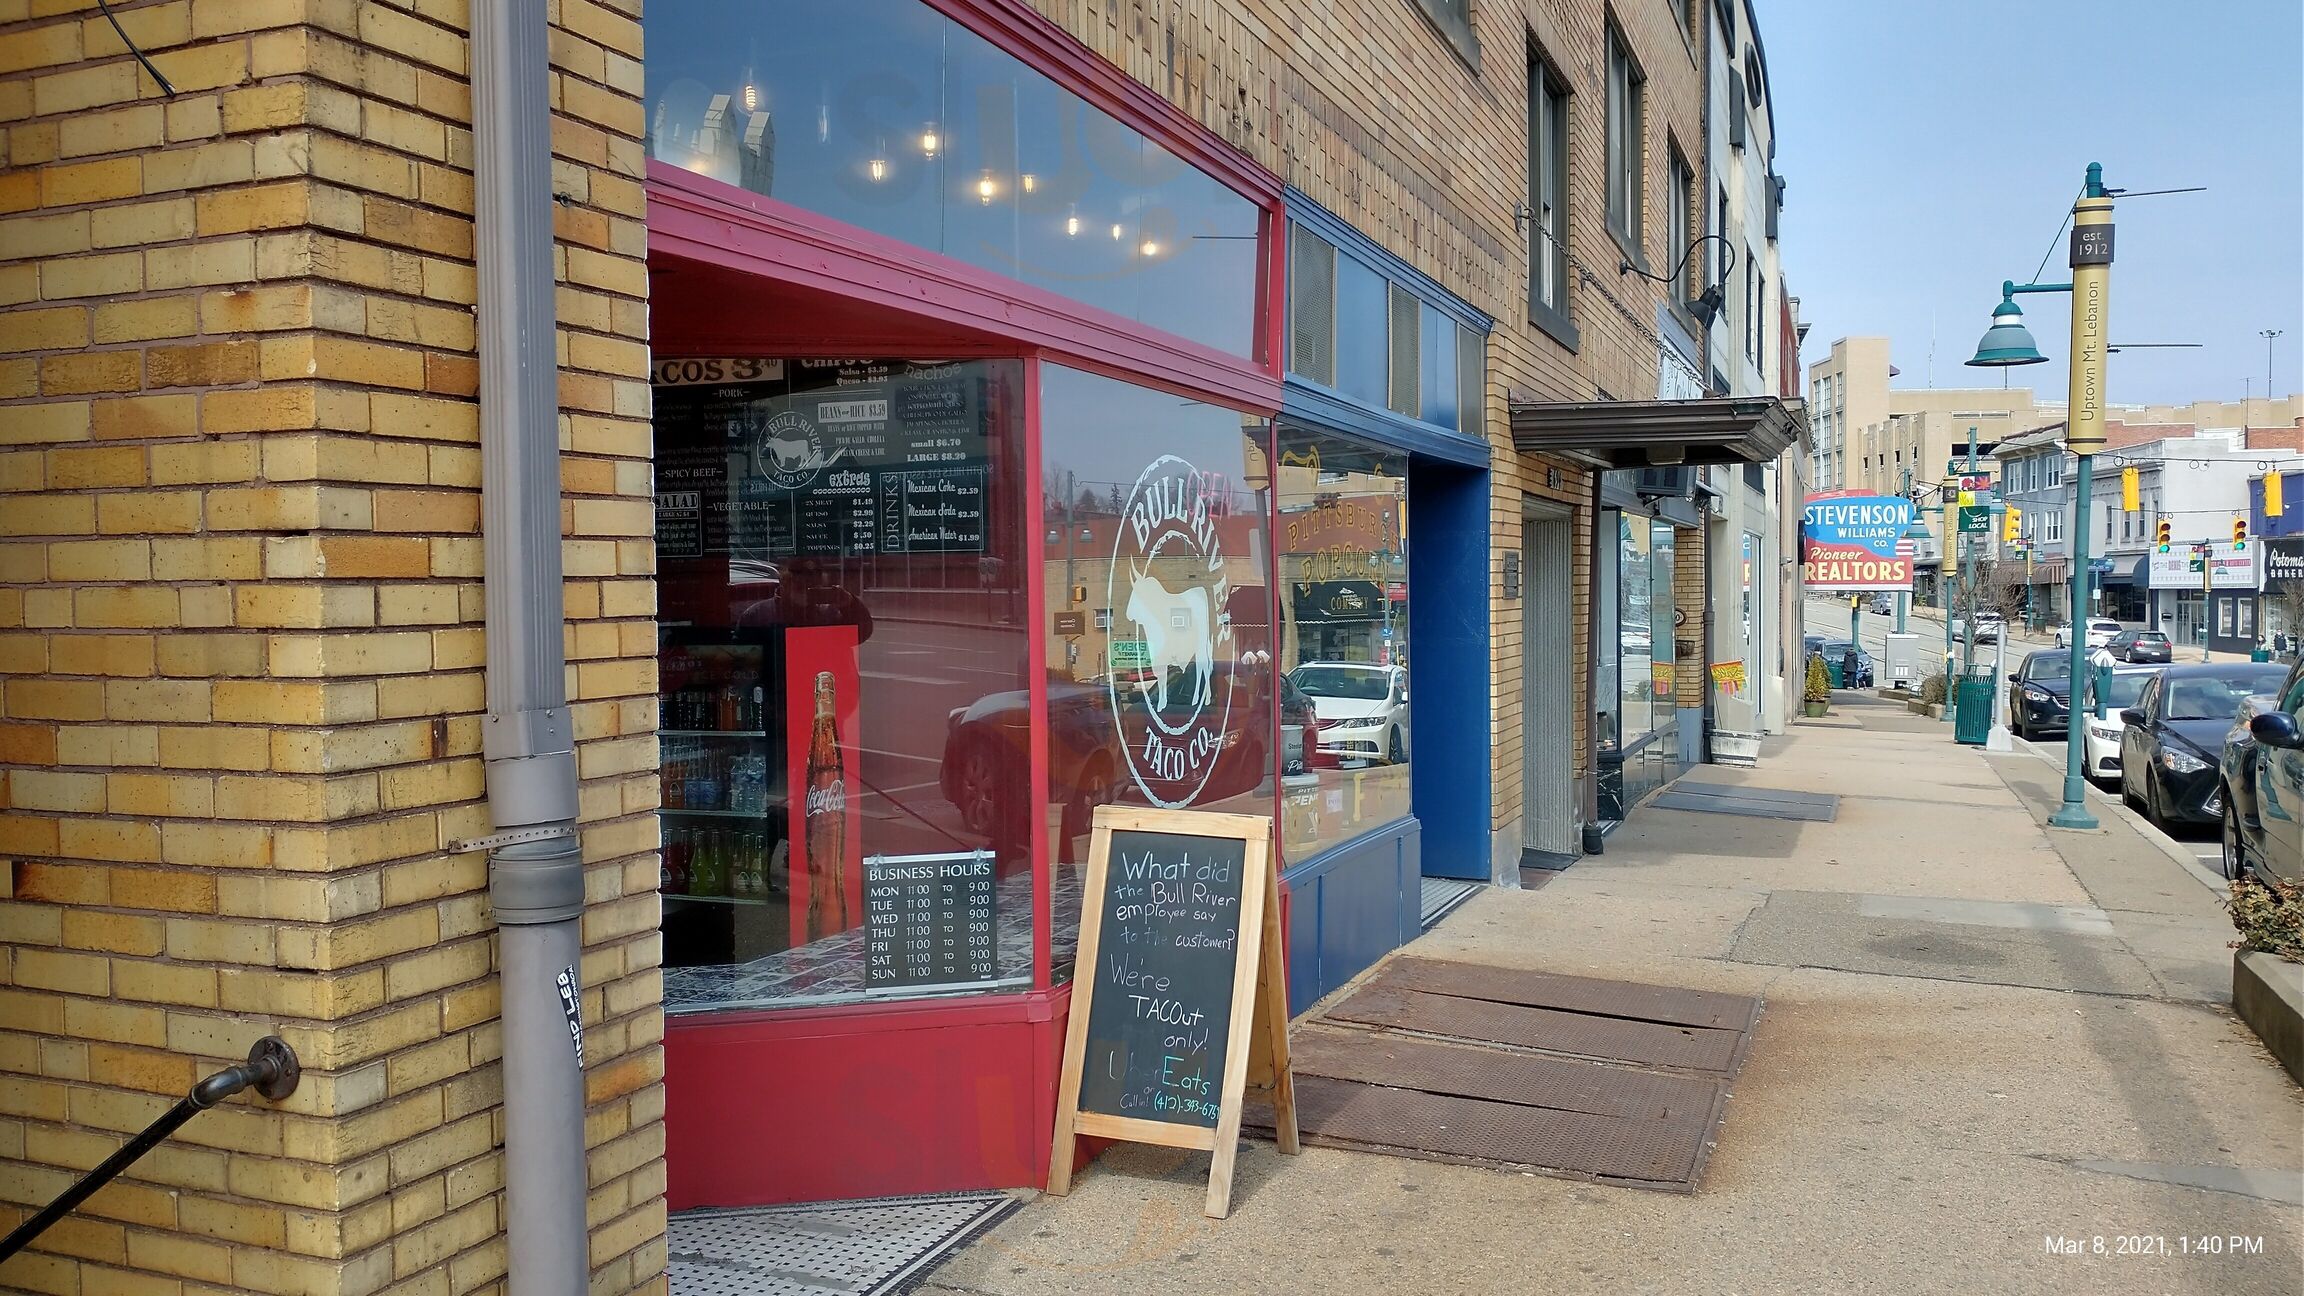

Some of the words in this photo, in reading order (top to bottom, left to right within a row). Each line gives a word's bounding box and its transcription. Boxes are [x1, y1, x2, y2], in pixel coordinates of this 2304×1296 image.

[2082, 230, 2105, 241] est.
[2079, 243, 2108, 256] 1912
[2083, 281, 2099, 337] Lebanon
[2083, 341, 2097, 364] Mt.
[904, 362, 962, 381] nachos
[2080, 366, 2099, 421] Uptown
[820, 406, 842, 419] BEANS
[768, 415, 797, 434] BULL
[799, 419, 822, 453] RIVER
[911, 439, 934, 448] small
[936, 438, 961, 447] $6.70
[907, 454, 939, 462] LARGE
[941, 452, 966, 461] $8.20
[665, 467, 691, 478] SPICY
[693, 467, 717, 477] BEEF
[773, 469, 794, 484] TACO
[829, 469, 871, 487] extras
[907, 480, 937, 493] Mexican
[938, 478, 956, 492] Coke
[957, 487, 979, 495] $2.59
[712, 501, 769, 511] VEGETABLE
[885, 474, 900, 549] DRINKS
[907, 504, 937, 517] Mexican
[938, 502, 956, 516] Soda
[958, 510, 979, 518] $2.59
[1804, 504, 1909, 526] STEVENSON
[908, 528, 938, 541] American
[939, 527, 957, 540] Water
[958, 534, 980, 542] $1.99
[1287, 503, 1399, 554] PITTSBURGH
[1837, 527, 1896, 538] WILLIAMS
[1810, 546, 1864, 560] Pioneer
[1873, 540, 1889, 548] CO.
[1130, 475, 1189, 554] BULL
[1190, 494, 1232, 648] RIVER
[1302, 541, 1390, 598] POPCORN
[1804, 561, 1905, 581] REALTORS
[1142, 725, 1186, 781] TACO
[869, 866, 934, 881] BUSINESS
[940, 863, 990, 878] HOURS
[1122, 850, 1191, 881] What
[1195, 856, 1230, 882] did
[870, 886, 899, 897] MON
[942, 884, 953, 892] TO
[1114, 883, 1145, 900] the
[1151, 881, 1185, 905] Bull
[1191, 882, 1236, 908] River
[871, 900, 893, 911] TUE
[942, 898, 954, 906] TO
[871, 913, 899, 924] WED
[1116, 903, 1187, 925] employee
[1193, 909, 1217, 922] say
[871, 927, 896, 938] THU
[943, 925, 954, 933] TO
[1119, 926, 1138, 944] to
[1175, 928, 1236, 950] customer?
[871, 941, 888, 952] FRI
[871, 955, 892, 966] SAT
[943, 952, 955, 960] TO
[872, 969, 896, 979] SUN
[943, 966, 955, 974] TO
[1110, 952, 1171, 992] We're
[1128, 994, 1205, 1026] TACOut
[1164, 1027, 1209, 1056] only!
[1162, 1055, 1211, 1096] Eats
